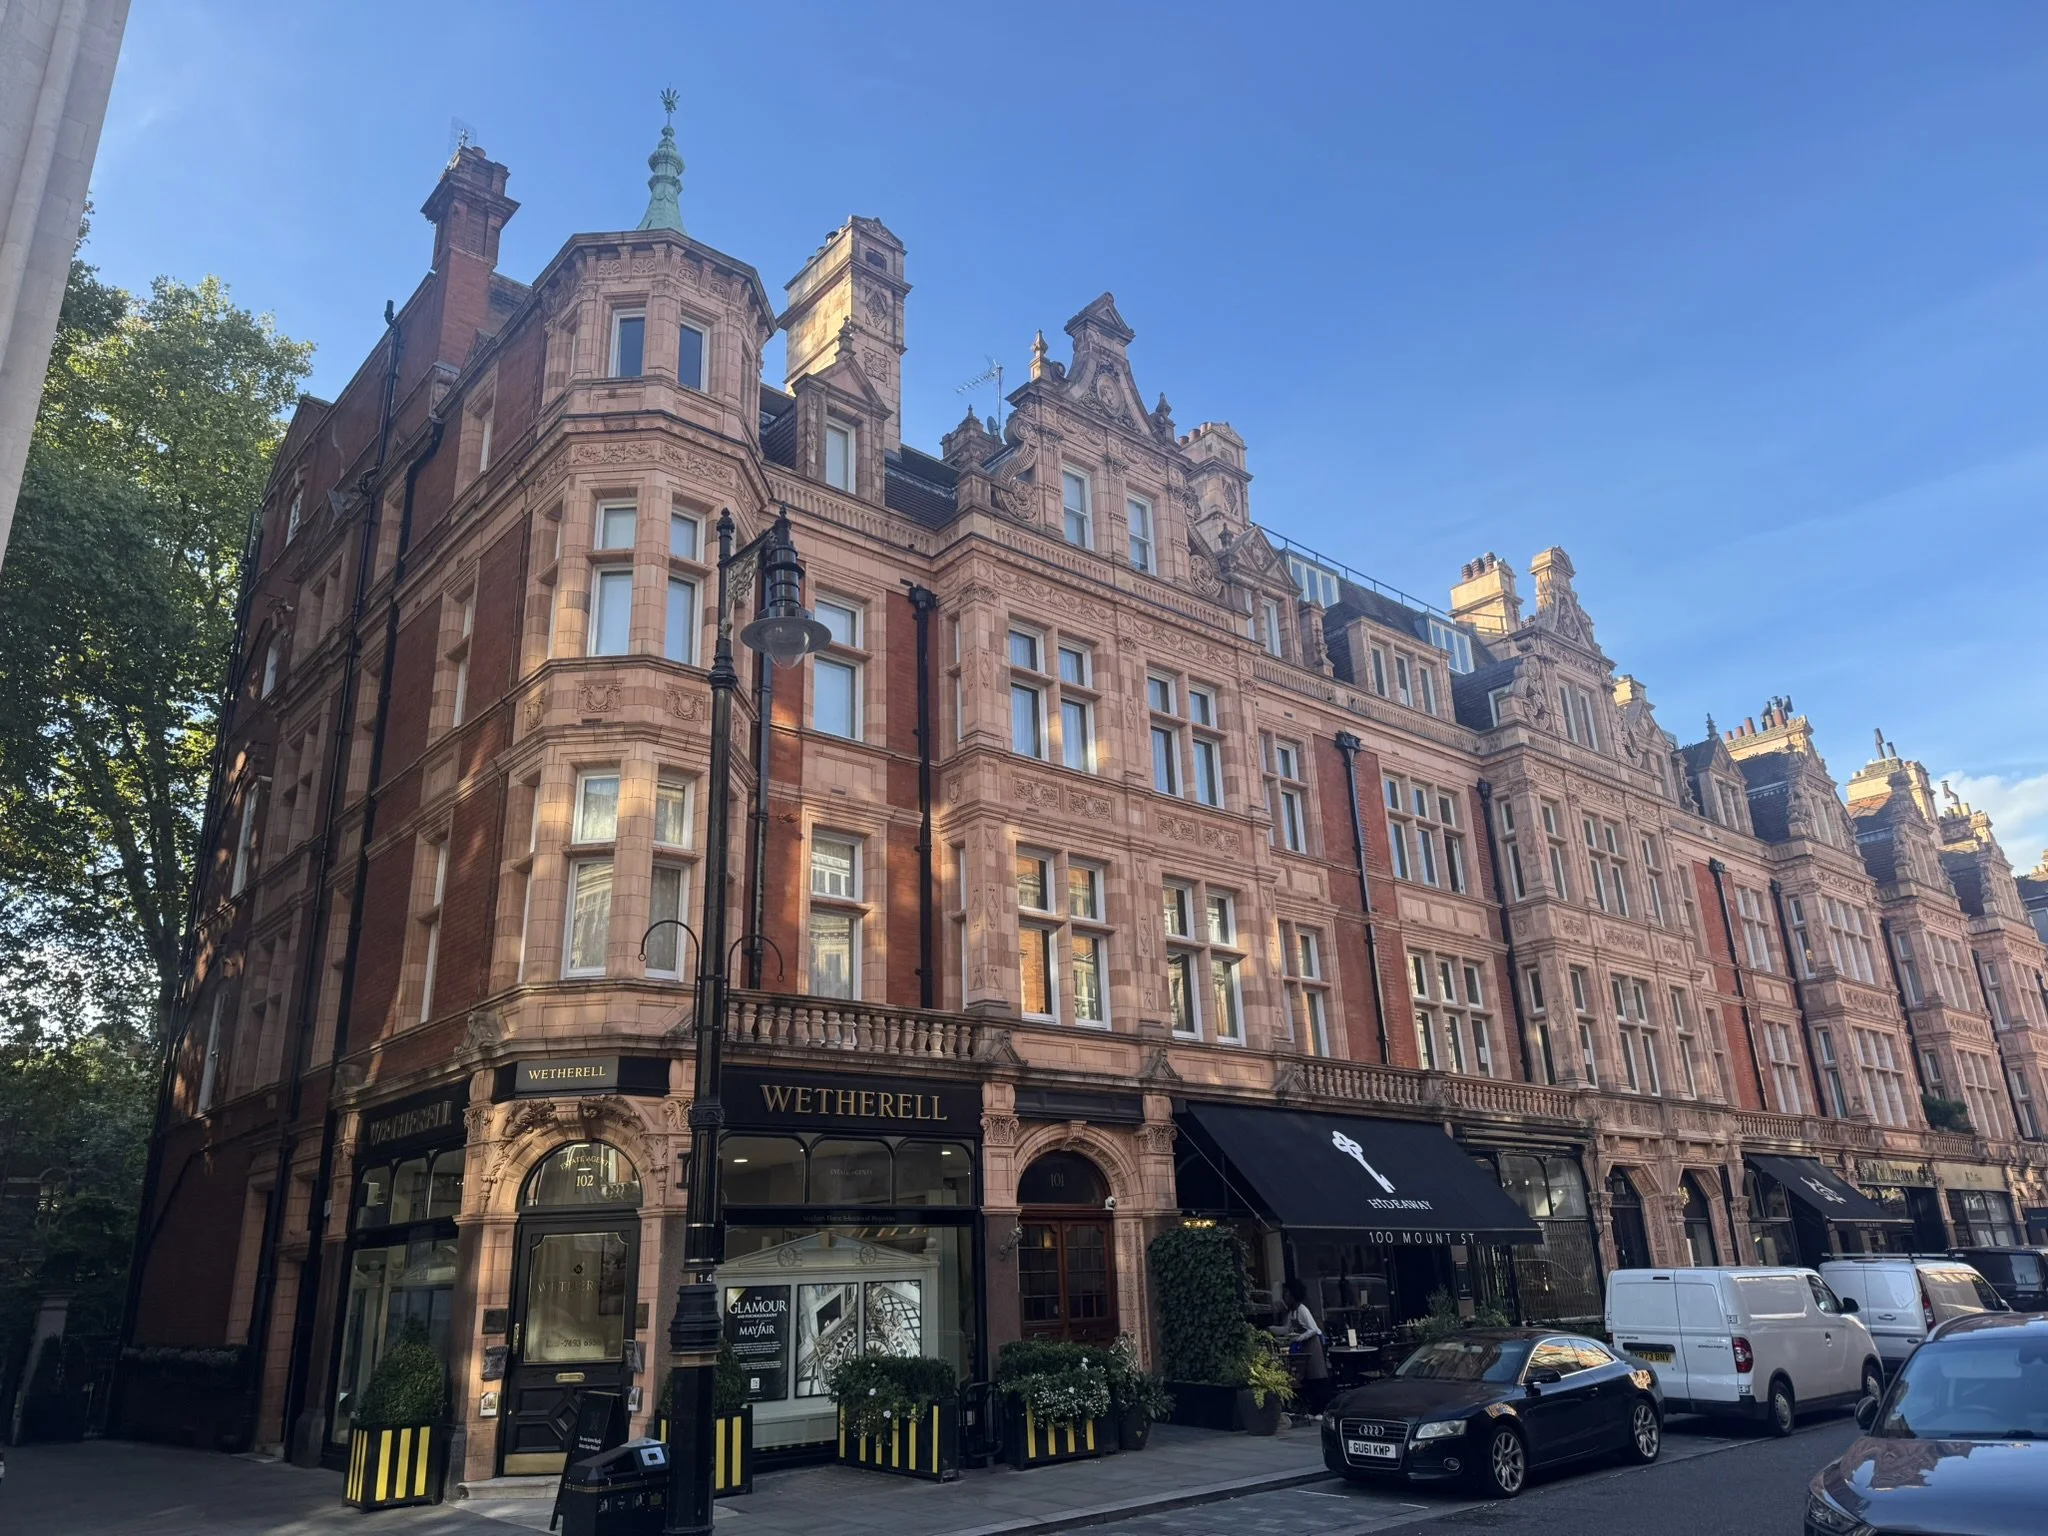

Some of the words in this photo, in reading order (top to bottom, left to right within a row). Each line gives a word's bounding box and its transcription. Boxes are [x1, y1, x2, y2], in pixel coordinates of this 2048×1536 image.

[528, 1065, 607, 1080] WETHERELL
[760, 1084, 948, 1121] WETHERELL
[576, 1174, 595, 1188] 102
[1050, 1172, 1065, 1188] 101
[1367, 1198, 1434, 1210] HIDEAWAY
[1369, 1232, 1394, 1244] 100
[1403, 1232, 1451, 1245] MOUNT
[1461, 1233, 1481, 1245] ST.
[729, 1300, 787, 1314] GLAMOUR
[1655, 1351, 1671, 1362] BNV
[1353, 1441, 1372, 1454] GU61
[1372, 1443, 1391, 1456] KWP
